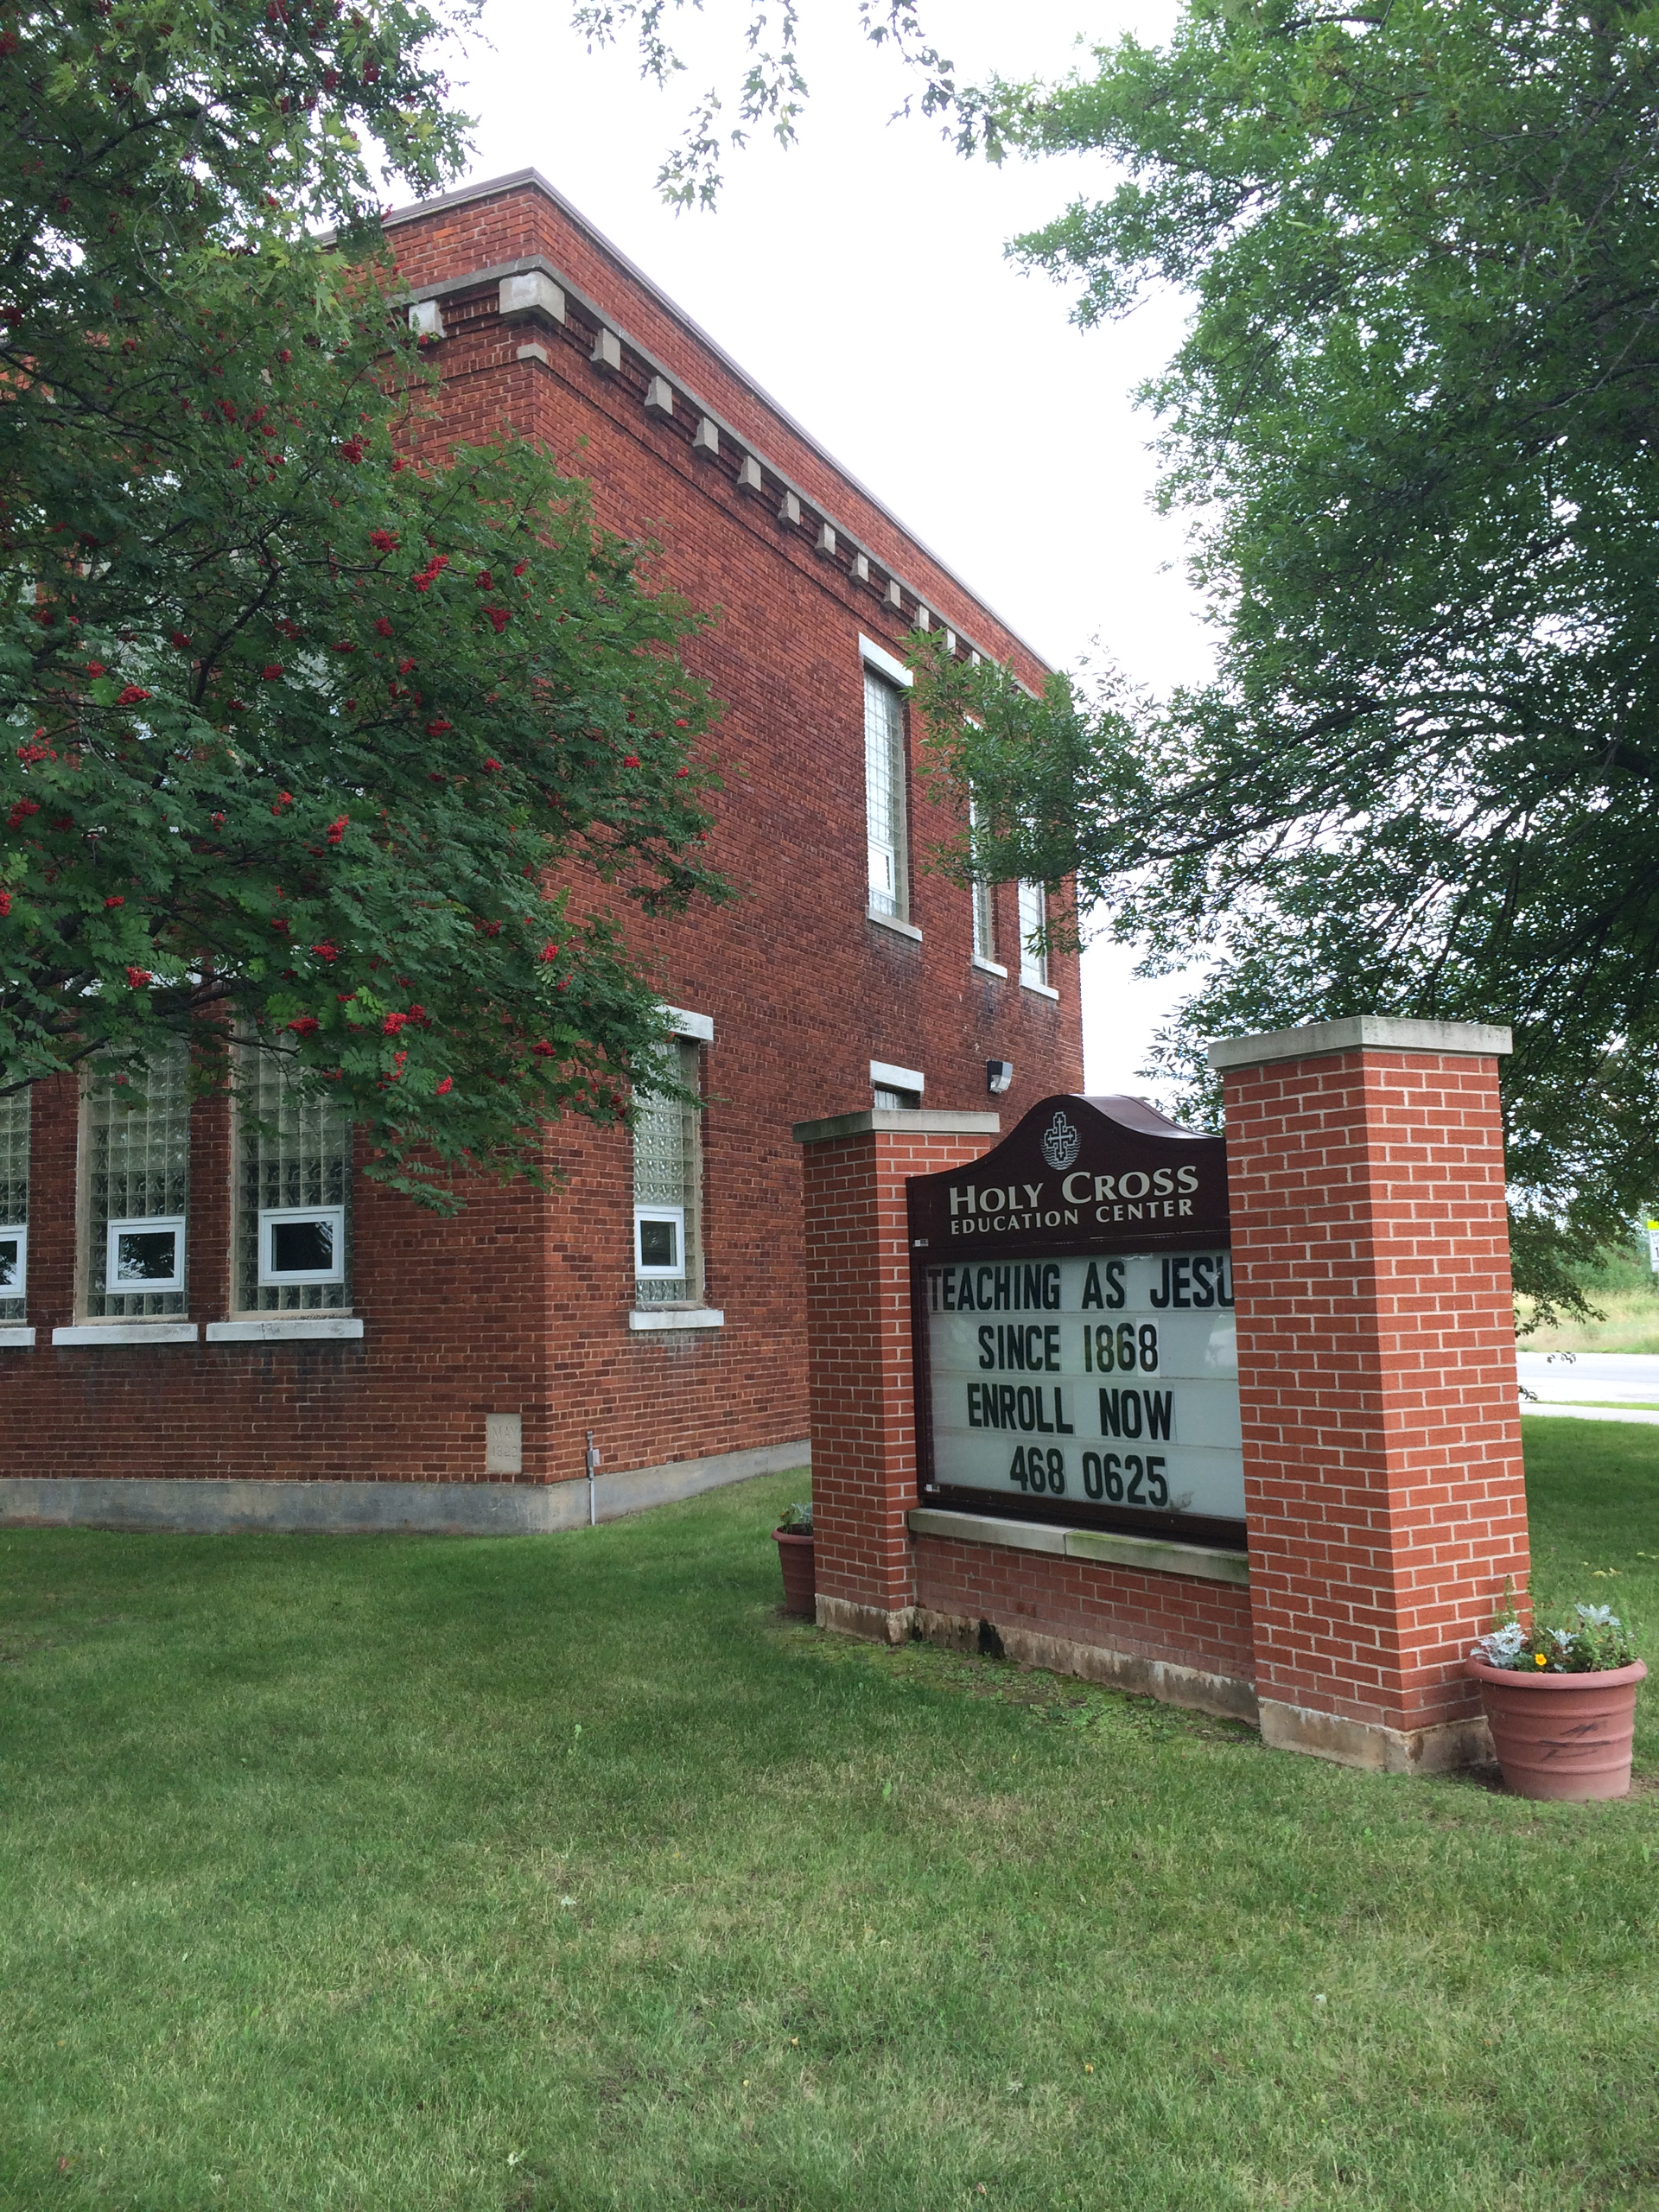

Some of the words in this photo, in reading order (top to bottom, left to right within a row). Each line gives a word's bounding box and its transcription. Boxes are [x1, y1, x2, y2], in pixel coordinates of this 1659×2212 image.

[950, 1183, 1044, 1216] HOLY
[1062, 1166, 1199, 1204] CROSS
[951, 1209, 1078, 1235] EDUCATION
[1096, 1198, 1194, 1223] CENTER
[928, 1263, 1060, 1311] TEACHING
[1082, 1262, 1125, 1310] AS
[978, 1325, 1060, 1371] SINCE
[1084, 1322, 1159, 1373] 1868
[493, 1426, 518, 1440] MAY
[968, 1383, 1073, 1434] ENROLL
[1100, 1388, 1173, 1440] NOW
[493, 1445, 518, 1458] 1922
[1010, 1446, 1065, 1495] 468
[1083, 1451, 1168, 1507] 0625
